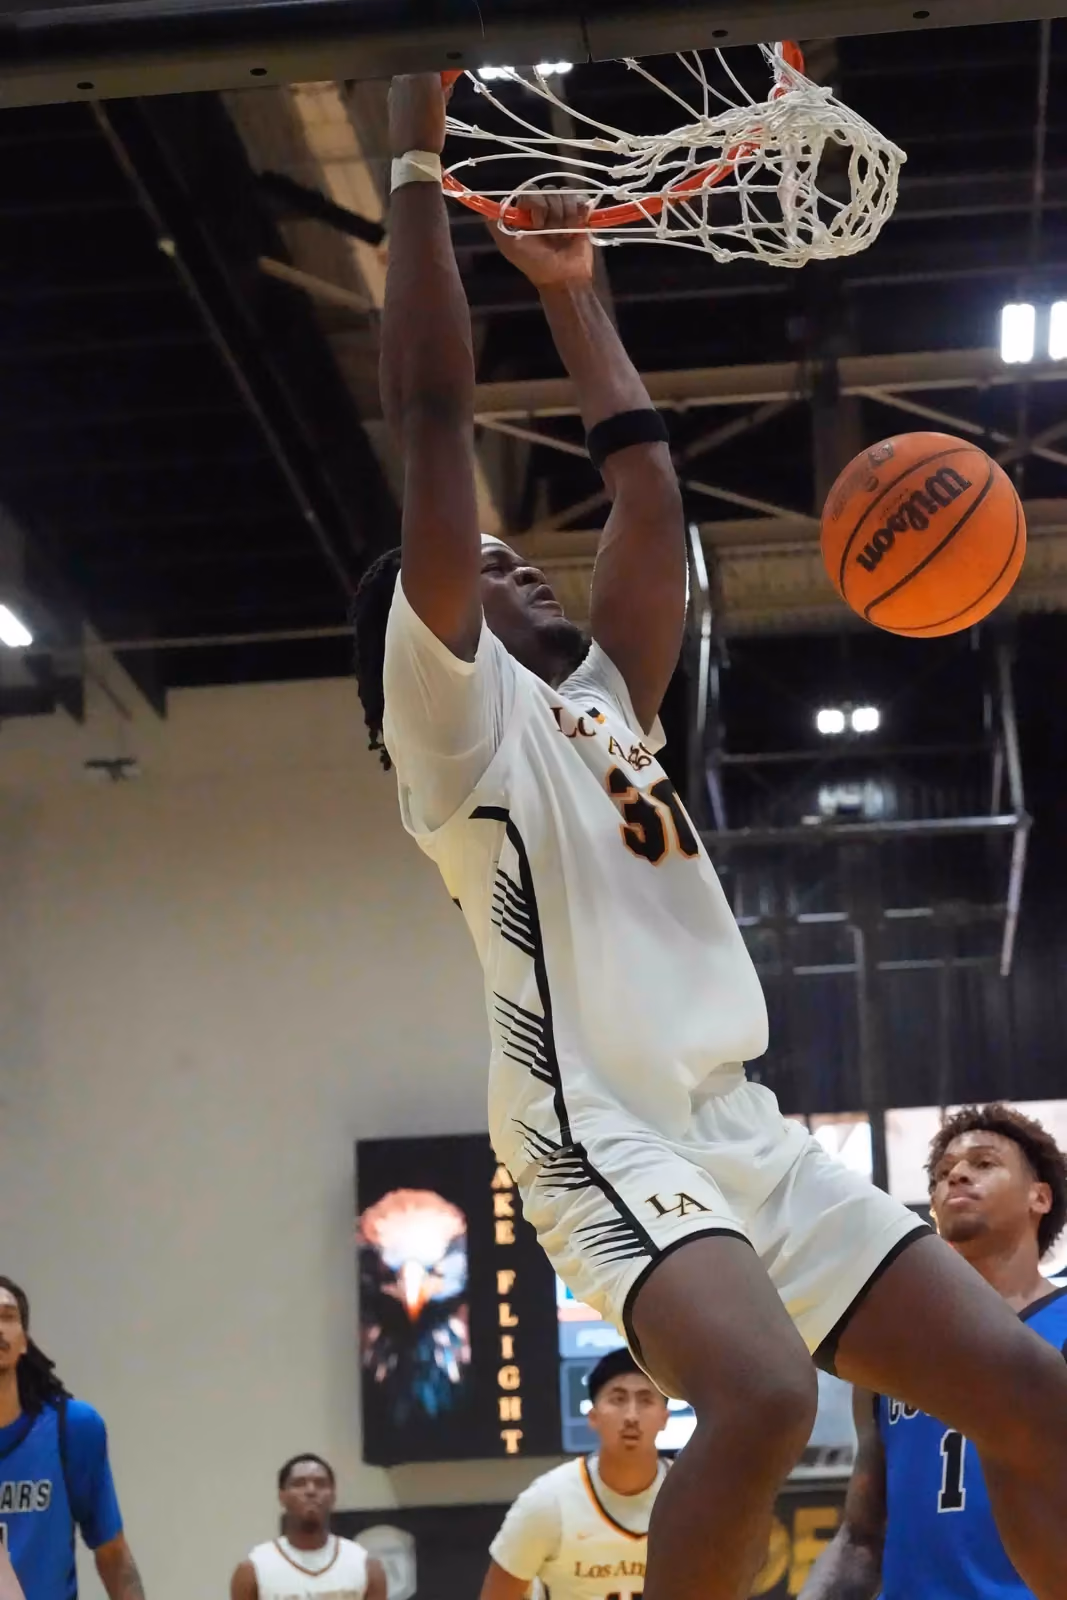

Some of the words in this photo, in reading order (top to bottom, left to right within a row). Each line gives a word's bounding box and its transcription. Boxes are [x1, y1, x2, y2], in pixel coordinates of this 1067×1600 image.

[856, 467, 972, 573] Wilson
[644, 1192, 713, 1219] LA
[496, 1269, 523, 1454] FLIGHT
[937, 1429, 967, 1513] 1
[574, 1561, 612, 1578] Los
